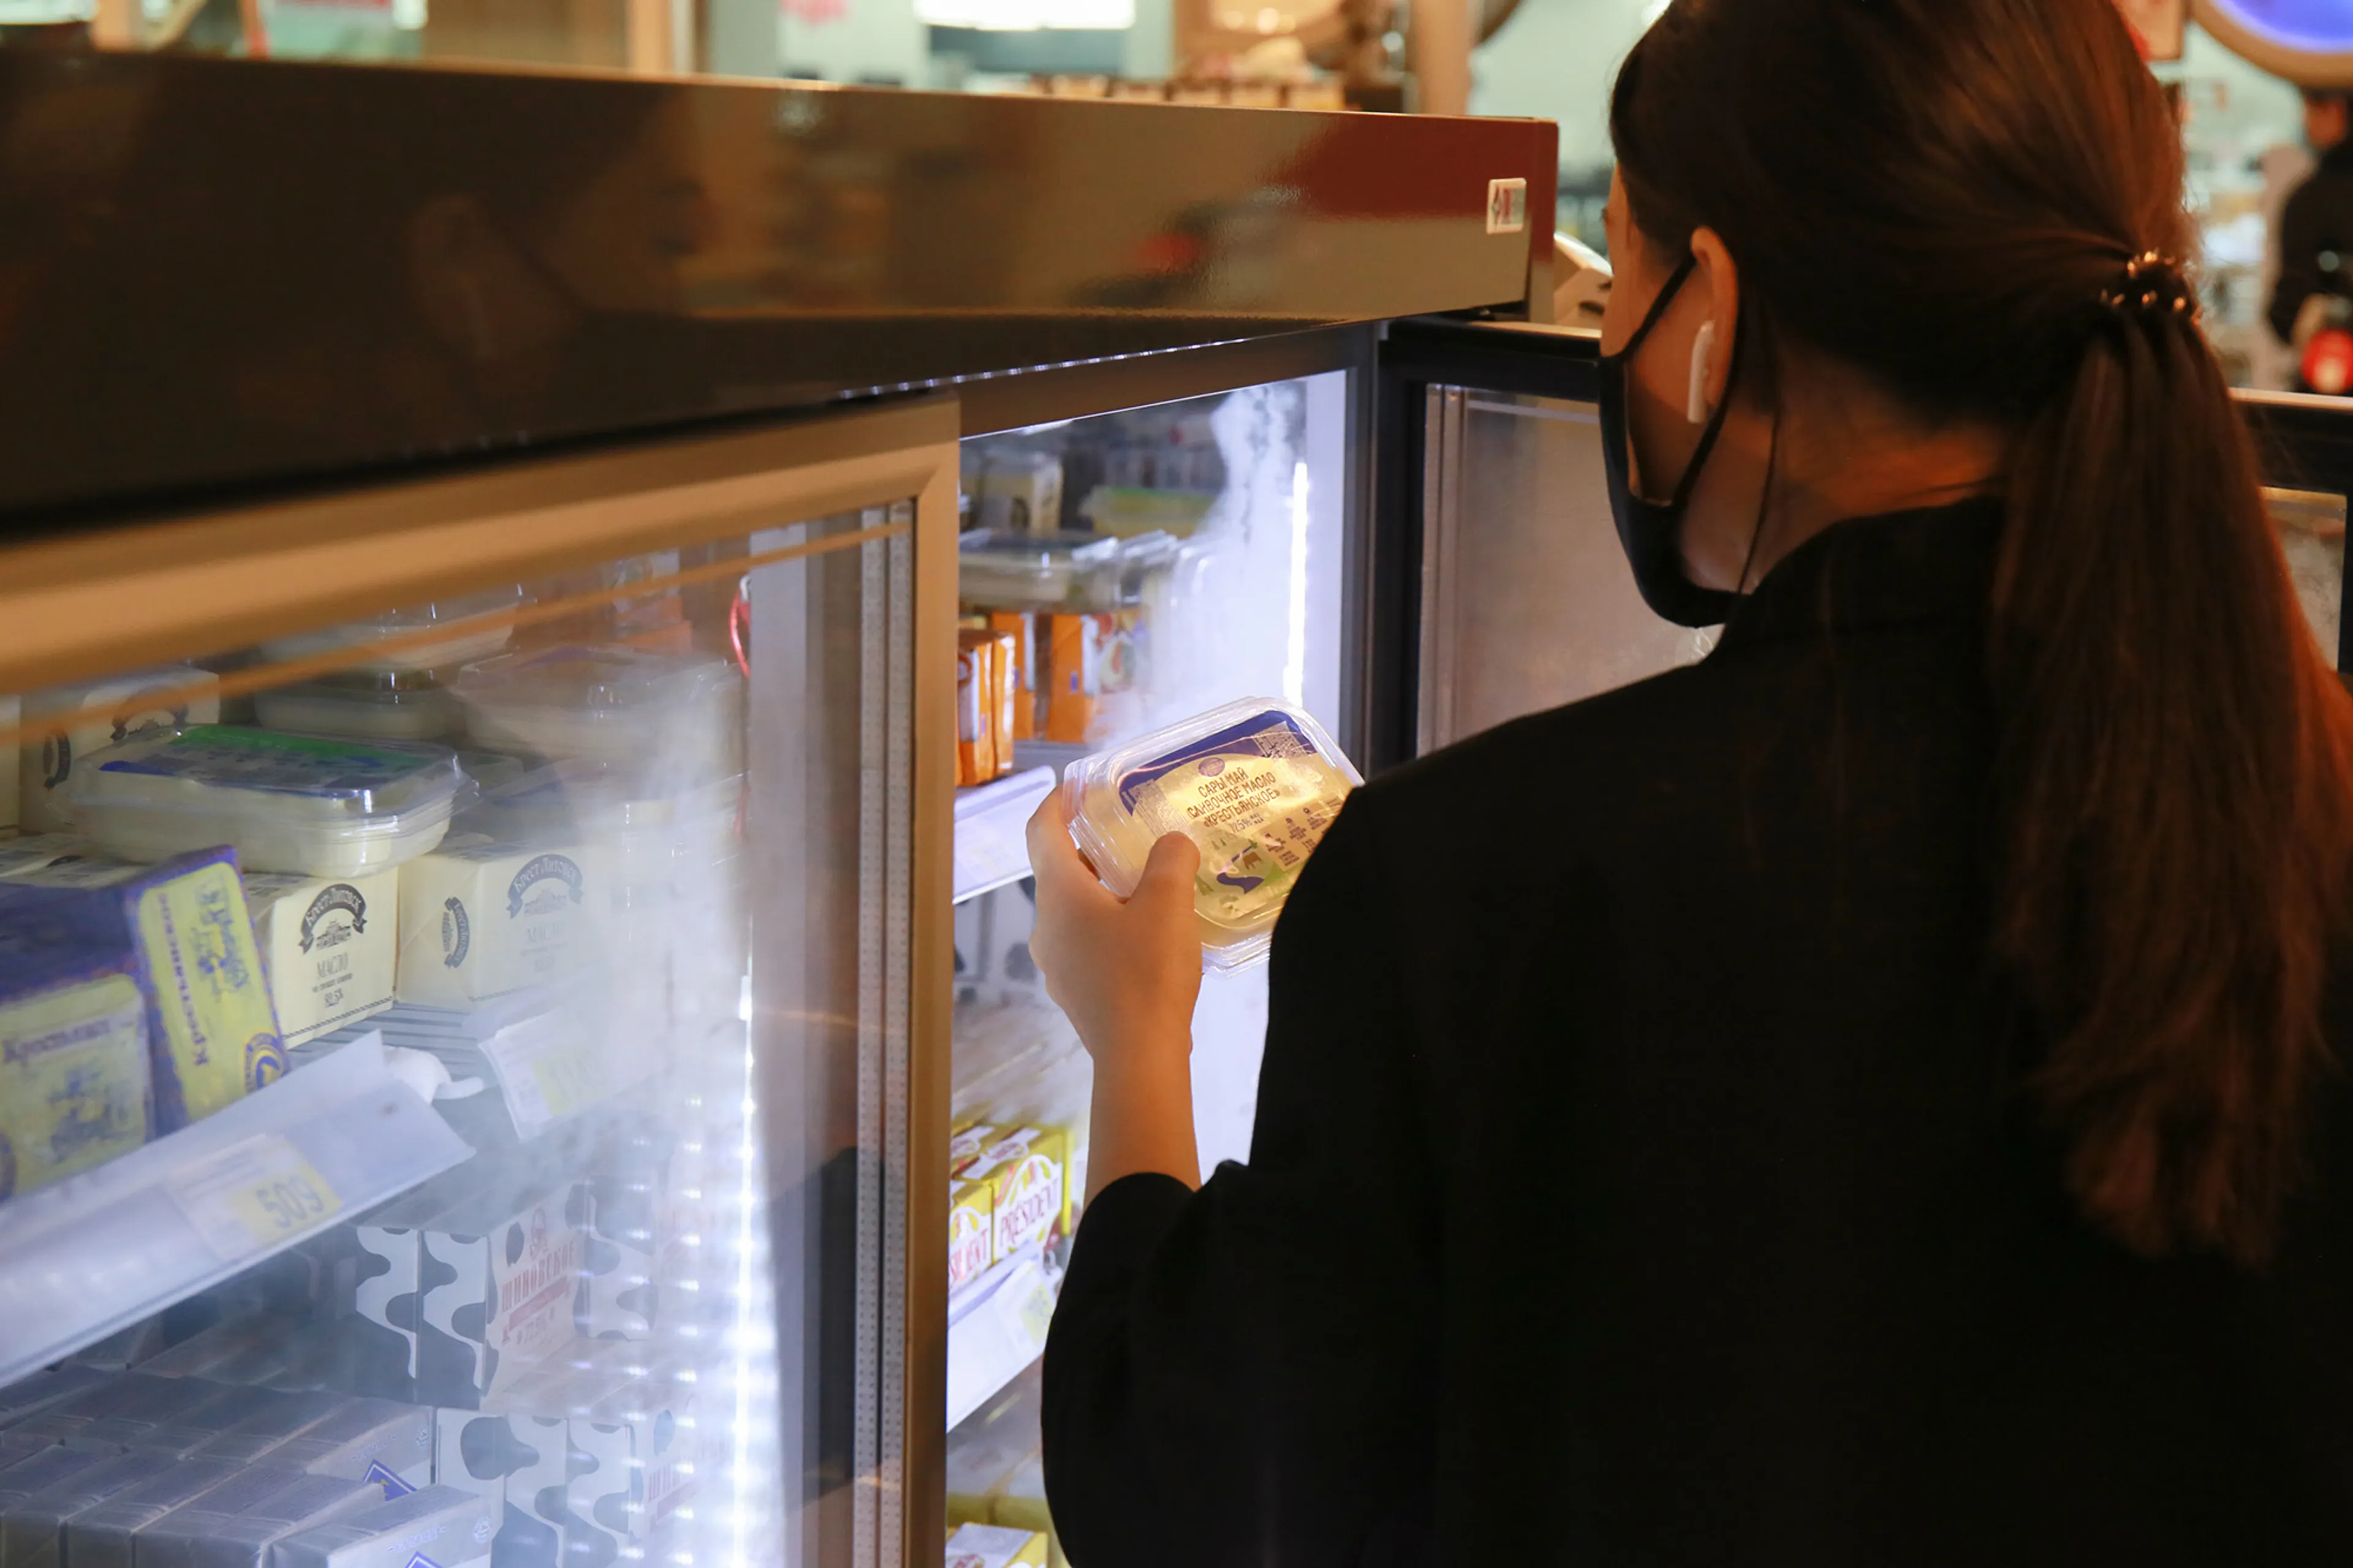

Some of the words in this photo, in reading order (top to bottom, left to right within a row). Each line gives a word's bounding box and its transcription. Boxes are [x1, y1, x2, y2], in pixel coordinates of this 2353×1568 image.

[1187, 786, 1244, 819] СЛИВОЧНОЕ
[1241, 772, 1276, 794] МАСЛО
[1198, 776, 1227, 797] САРЫ
[1226, 767, 1249, 786] МАЙ
